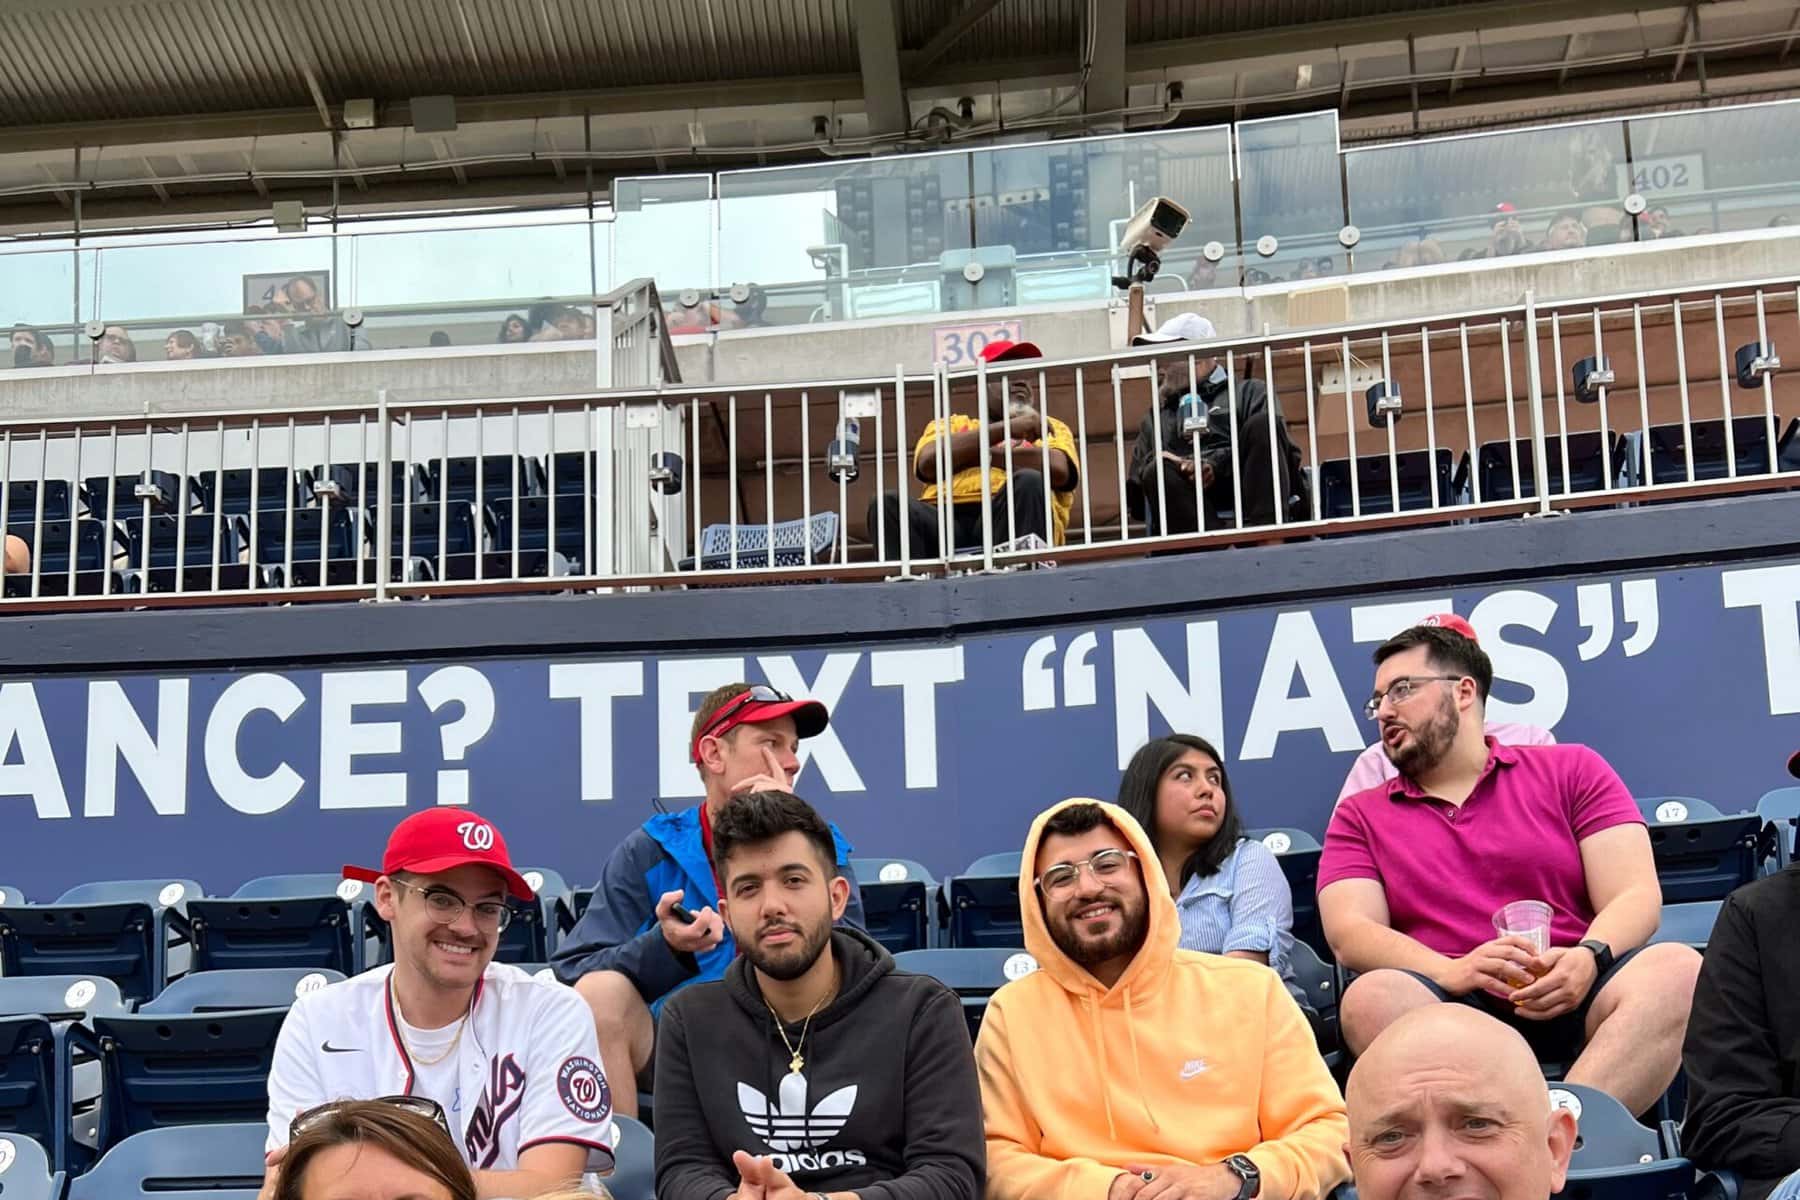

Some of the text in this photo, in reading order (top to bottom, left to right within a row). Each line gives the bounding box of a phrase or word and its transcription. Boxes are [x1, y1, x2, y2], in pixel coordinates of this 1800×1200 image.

[1632, 163, 1689, 192] 402
[549, 645, 965, 801] TEXT
[1664, 807, 1680, 819] 17
[457, 821, 494, 850] W
[561, 1060, 608, 1090] WASHINGTON
[573, 1077, 597, 1103] W
[564, 1095, 608, 1120] NATIONALS
[753, 1149, 867, 1174] didas
